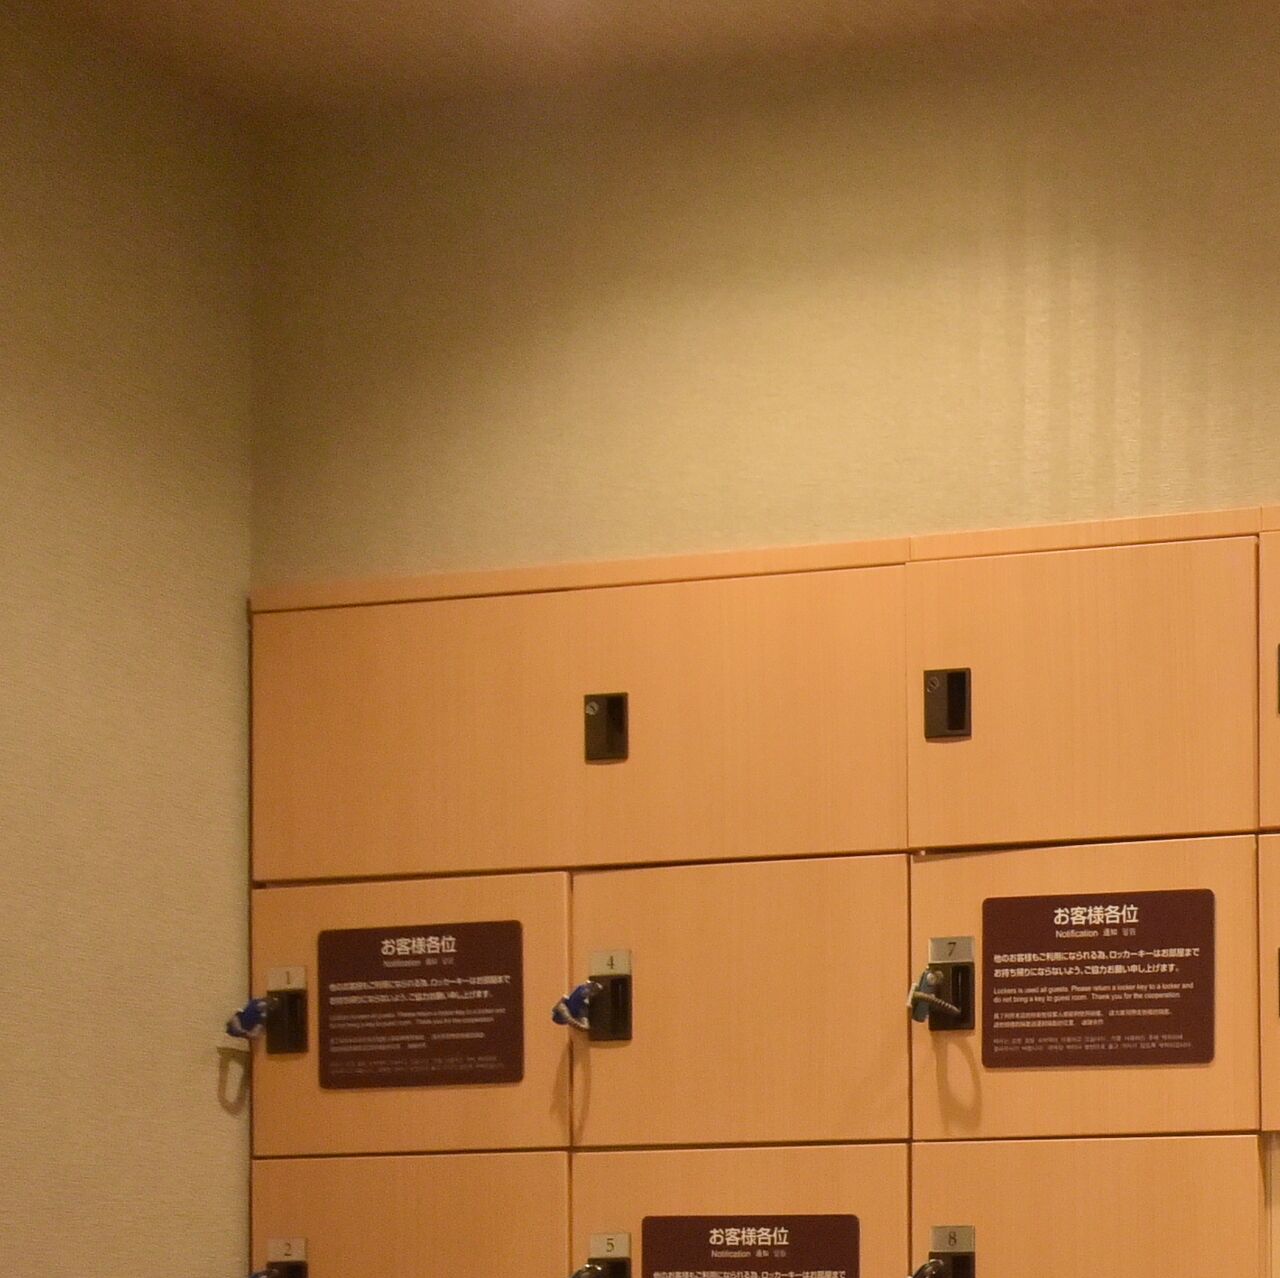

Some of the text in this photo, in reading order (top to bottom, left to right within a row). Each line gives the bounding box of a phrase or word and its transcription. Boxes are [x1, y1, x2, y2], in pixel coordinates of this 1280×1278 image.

[1053, 903, 1139, 926] お客様各位
[1055, 928, 1098, 938] Notification
[947, 942, 956, 957] 7
[606, 955, 615, 969] 4
[284, 970, 291, 985] 1
[709, 1226, 789, 1246] お客様各位
[948, 1231, 957, 1247] 8
[284, 1243, 292, 1257] 2
[606, 1238, 615, 1253] 5
